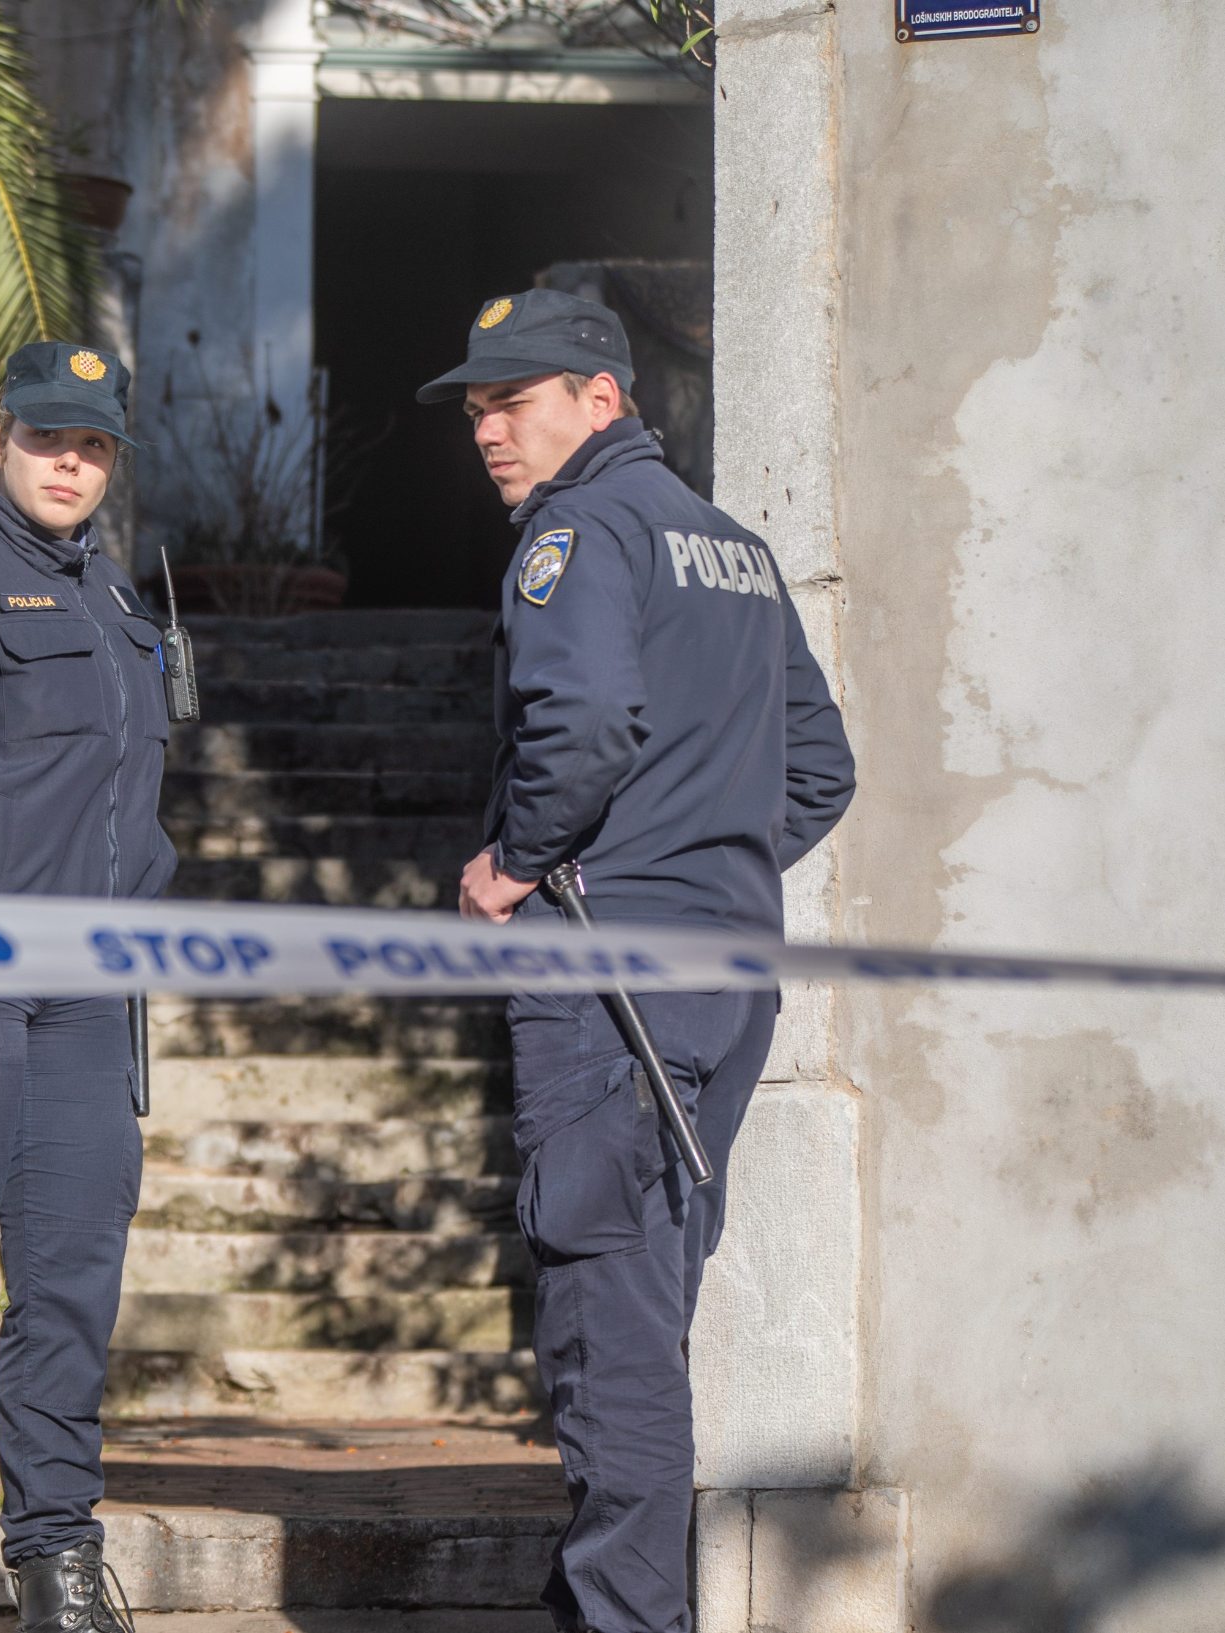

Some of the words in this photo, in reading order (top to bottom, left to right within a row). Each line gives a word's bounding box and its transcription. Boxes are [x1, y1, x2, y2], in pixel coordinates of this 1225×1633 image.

[911, 11, 952, 25] LOŠINJSKIH
[953, 6, 1024, 21] BRODOGRADITELJA
[664, 531, 781, 604] POLICIJA
[7, 596, 57, 608] POLICIJA
[88, 929, 273, 976] STOP
